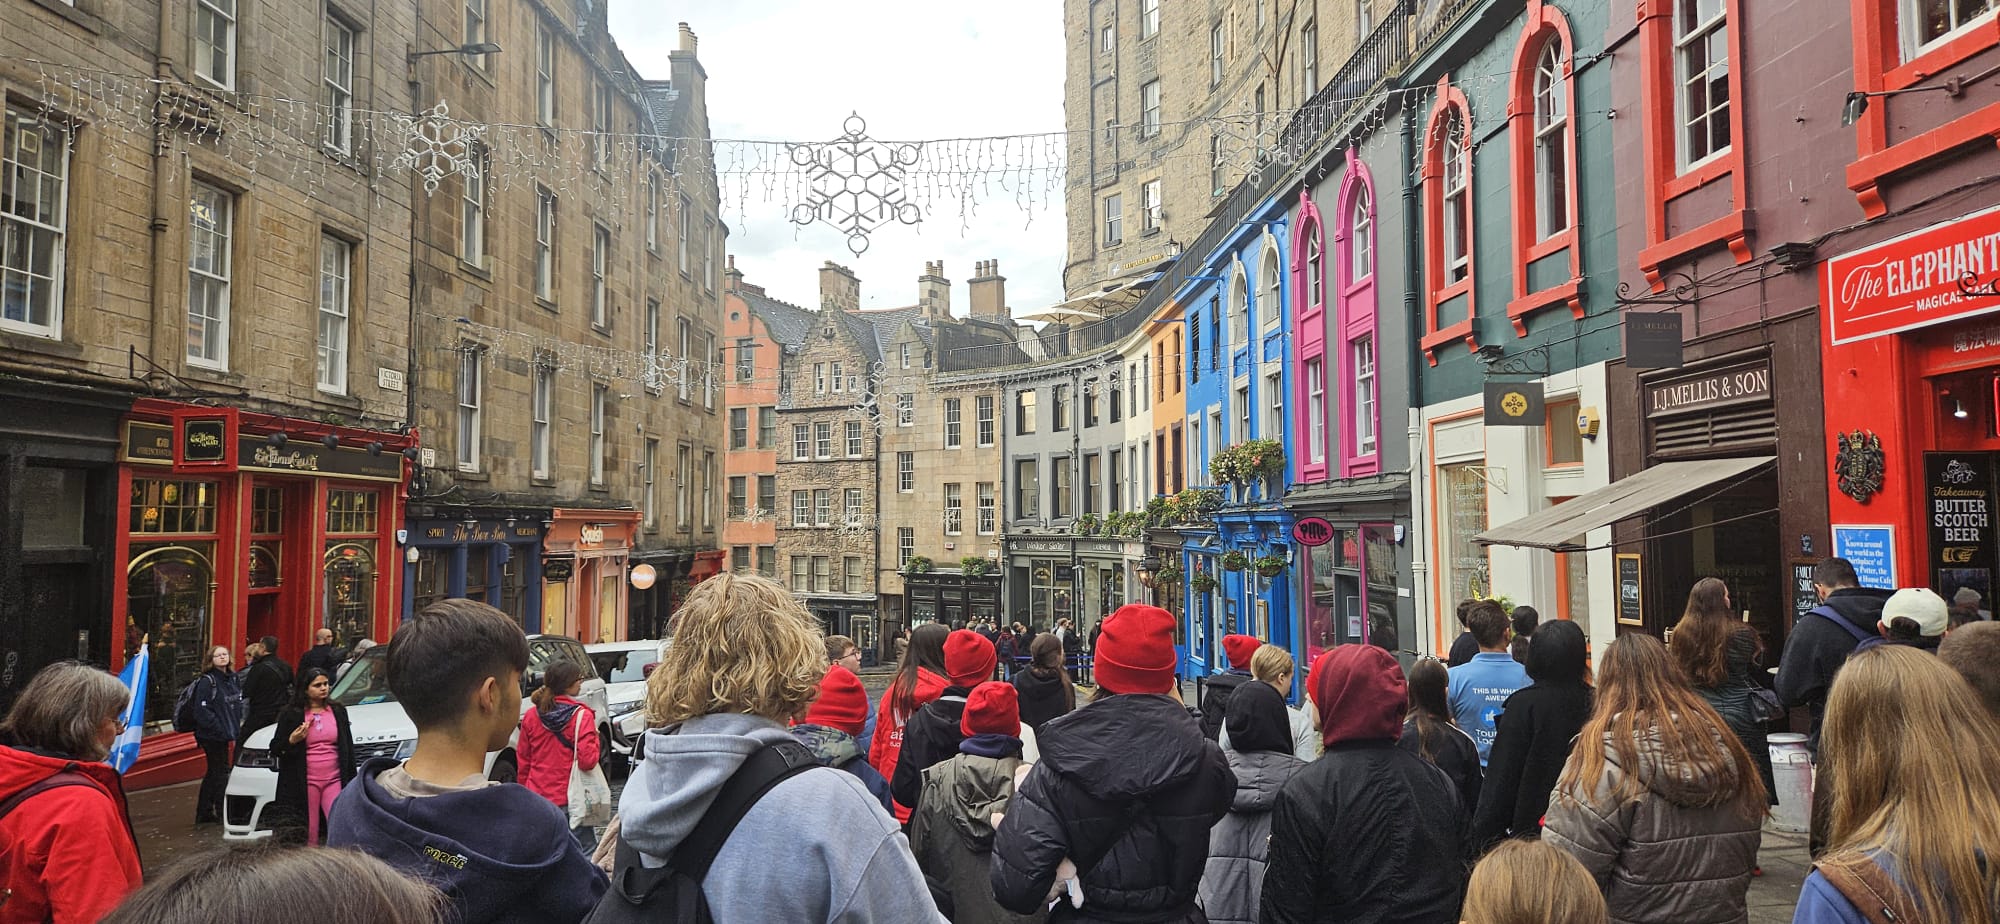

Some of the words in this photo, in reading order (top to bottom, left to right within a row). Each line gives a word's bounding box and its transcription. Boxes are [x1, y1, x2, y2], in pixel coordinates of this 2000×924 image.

[1841, 256, 1889, 311] The
[1886, 233, 2000, 298] ELEPHANT
[1916, 291, 1963, 312] MAGICAL
[1721, 376, 1731, 397] &
[1735, 369, 1768, 396] SON
[1933, 486, 1986, 498] Takeaway
[1935, 500, 1987, 513] BUTTER
[1934, 513, 1988, 528] SCOTCH
[453, 523, 469, 543] The
[1944, 527, 1980, 542] BEER
[1472, 687, 1490, 695] THIS
[1490, 687, 1499, 695] IS
[1499, 687, 1519, 695] WHA
[423, 845, 465, 870] FORCE
